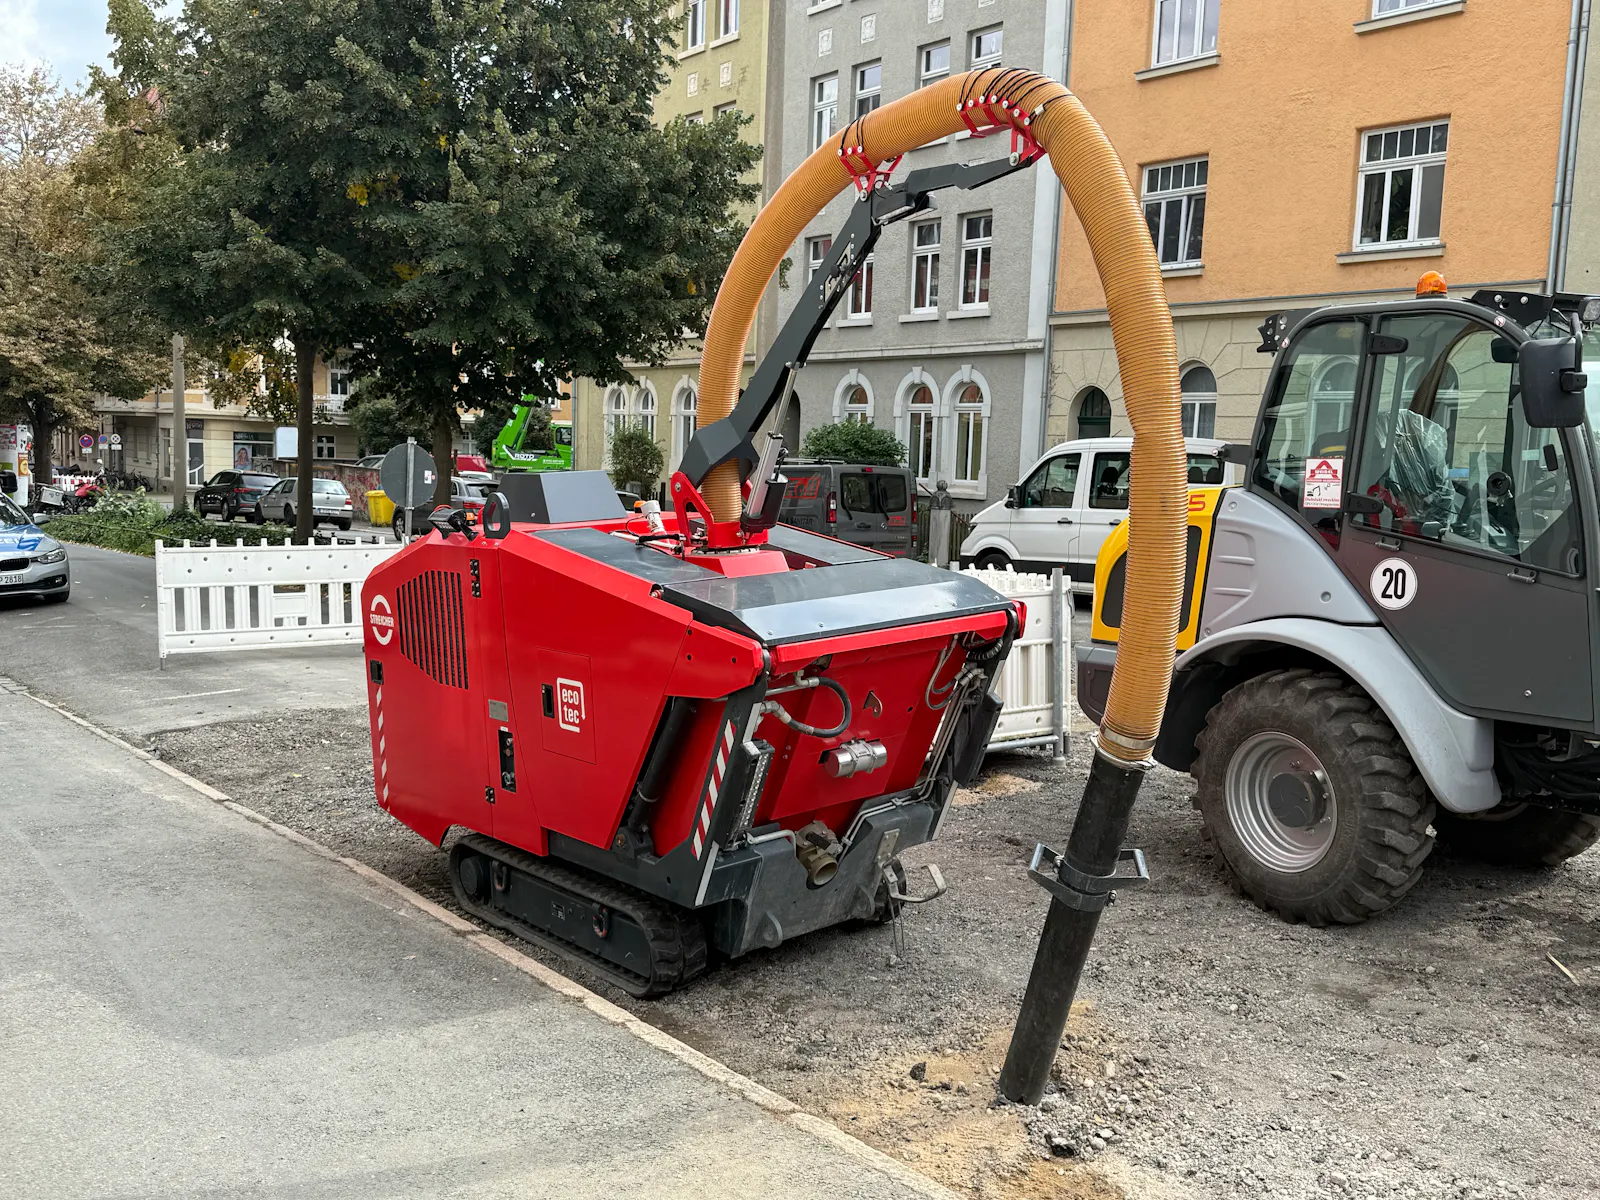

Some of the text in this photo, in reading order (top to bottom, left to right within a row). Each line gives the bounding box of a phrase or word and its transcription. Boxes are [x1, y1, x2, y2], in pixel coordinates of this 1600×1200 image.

[1381, 567, 1406, 600] 20
[370, 613, 394, 627] STREICHER
[562, 688, 579, 705] eco
[563, 704, 580, 724] tec
